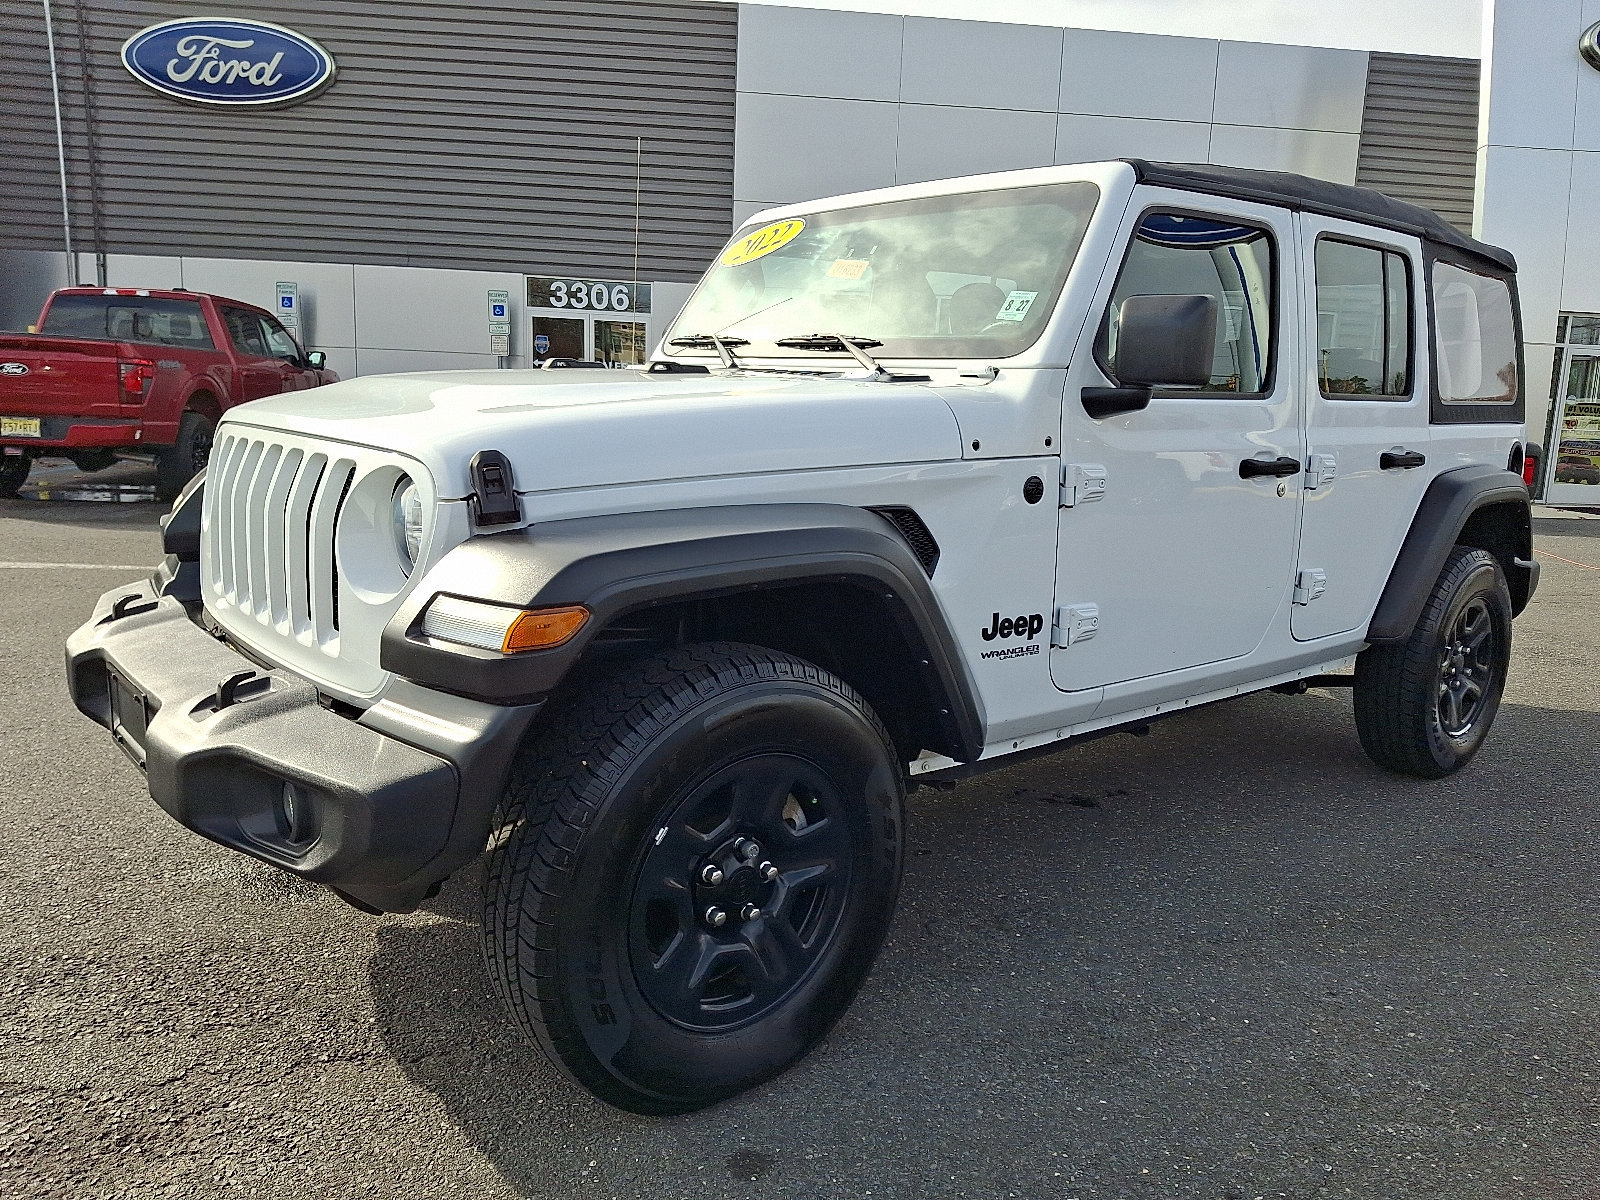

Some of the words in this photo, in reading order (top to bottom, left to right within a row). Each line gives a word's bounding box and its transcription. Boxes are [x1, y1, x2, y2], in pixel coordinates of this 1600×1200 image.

[166, 35, 285, 87] Ford
[730, 222, 794, 262] 2022
[549, 281, 630, 311] 3306
[1005, 299, 1014, 311] 8
[1016, 299, 1030, 311] 27
[2, 364, 23, 374] Ford
[981, 612, 1044, 641] Jeep
[980, 644, 1040, 659] WRANGLER
[999, 650, 1040, 660] UNLIMITED
